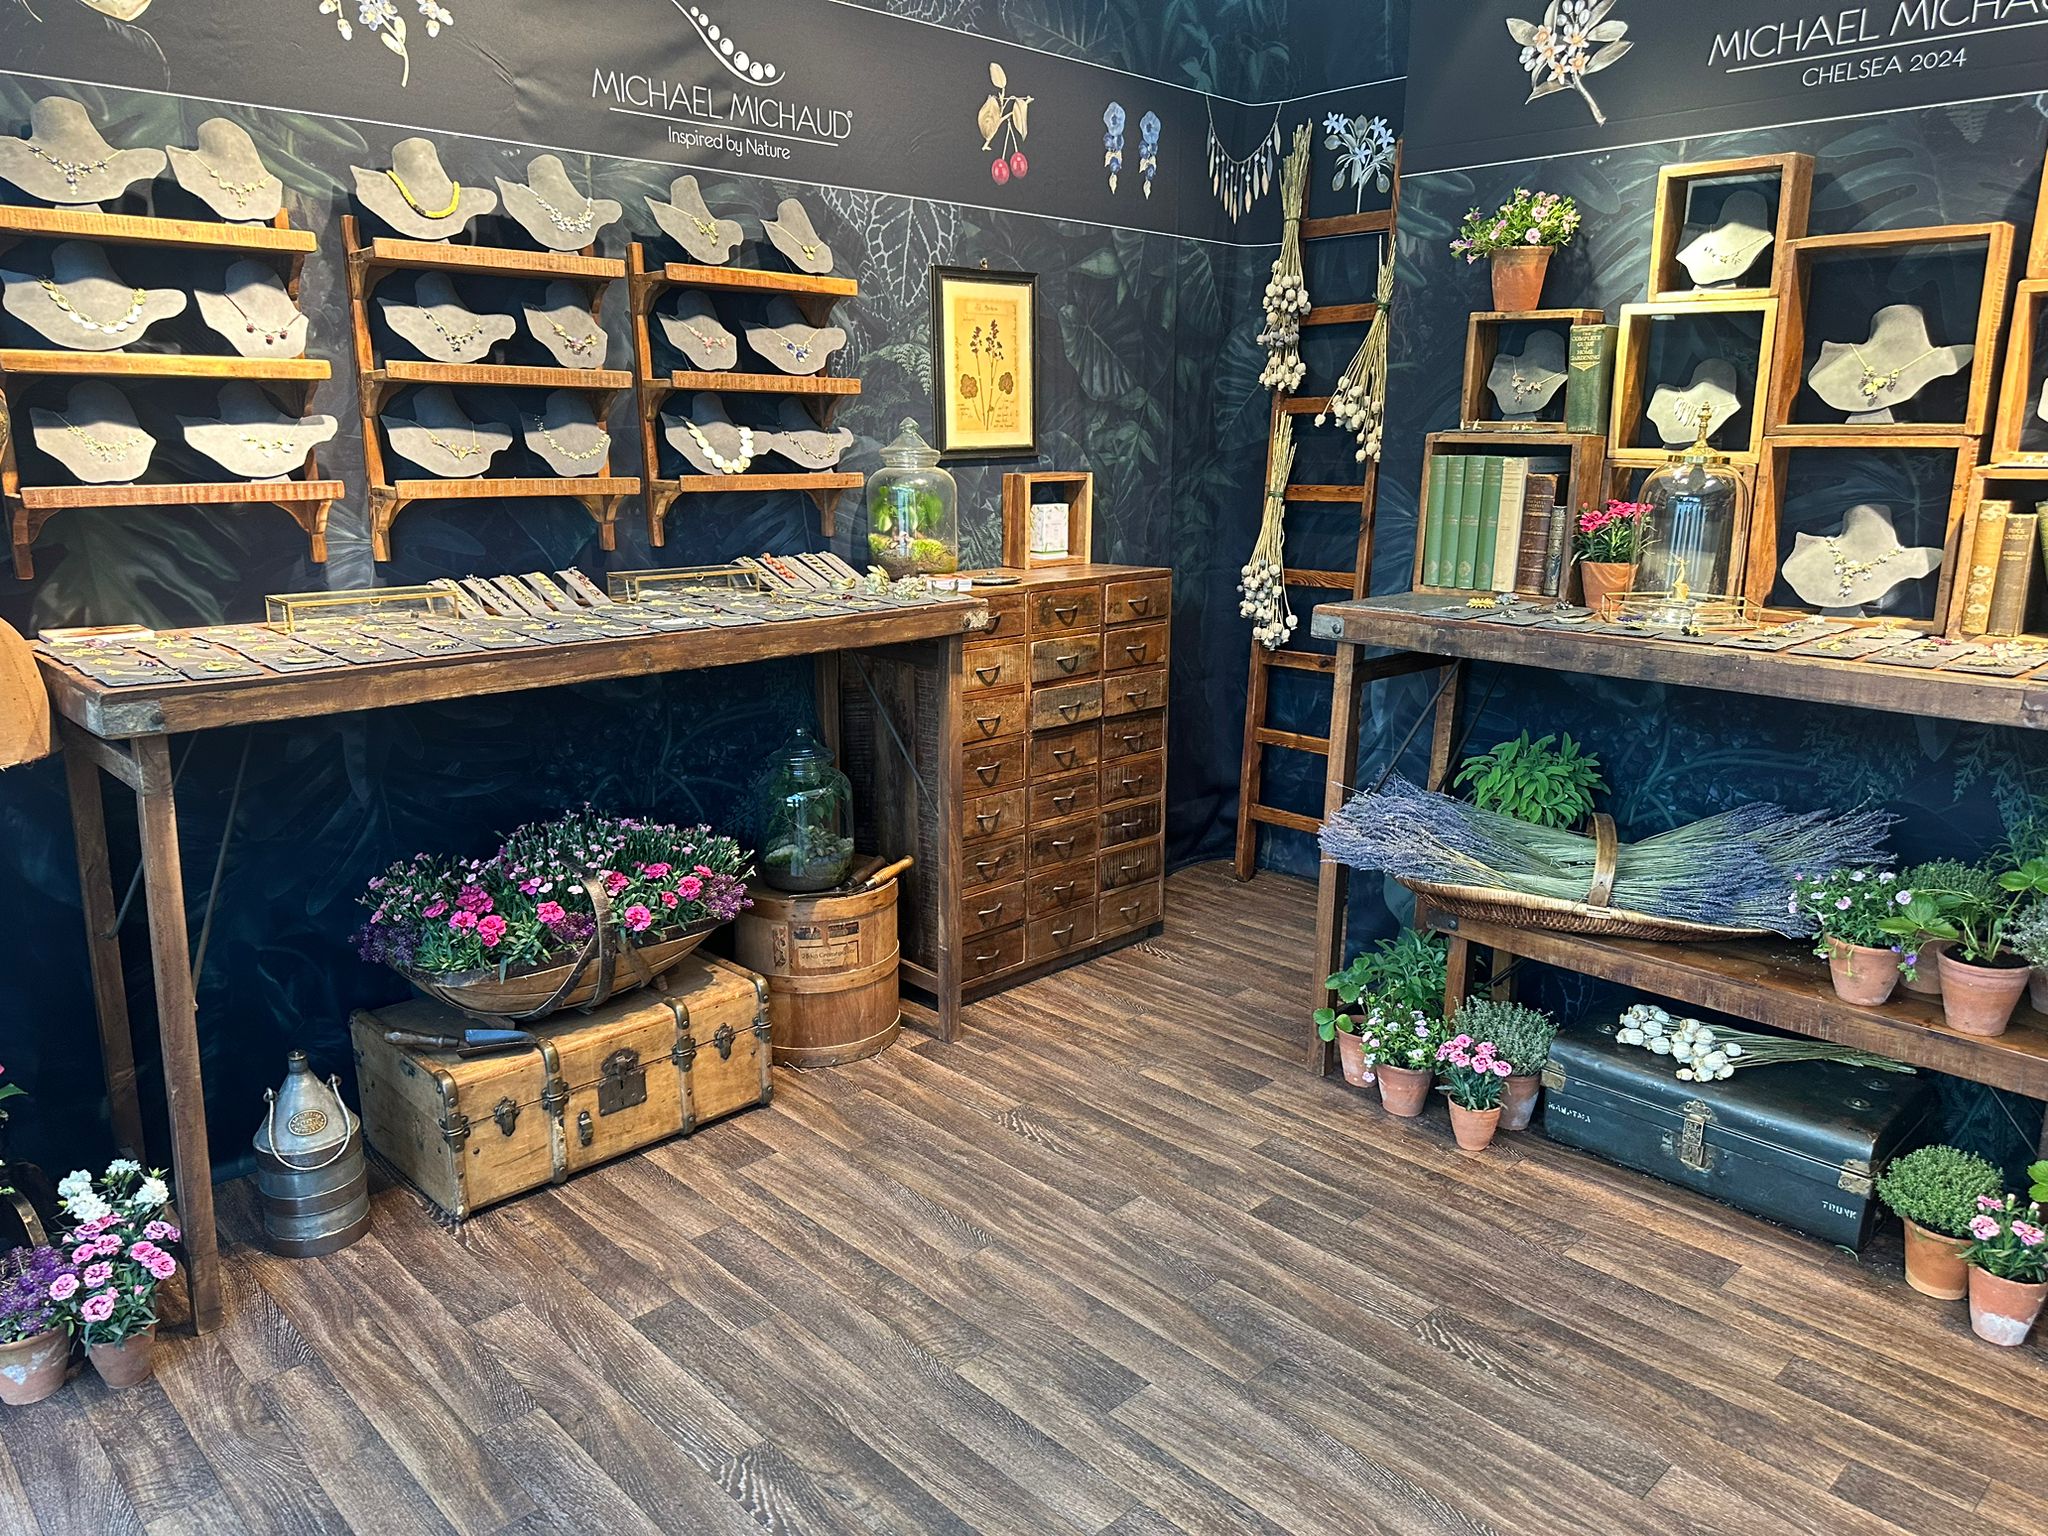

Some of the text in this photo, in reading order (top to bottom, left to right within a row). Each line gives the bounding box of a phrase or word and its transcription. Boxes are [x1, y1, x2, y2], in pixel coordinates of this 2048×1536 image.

[1707, 7, 1880, 67] MICHAEL
[1802, 47, 1968, 87] CHELSEA 2024
[591, 67, 724, 120] MICHAEL
[667, 125, 791, 160] Inspired by Nature
[1821, 1200, 1857, 1220] TRUNK
